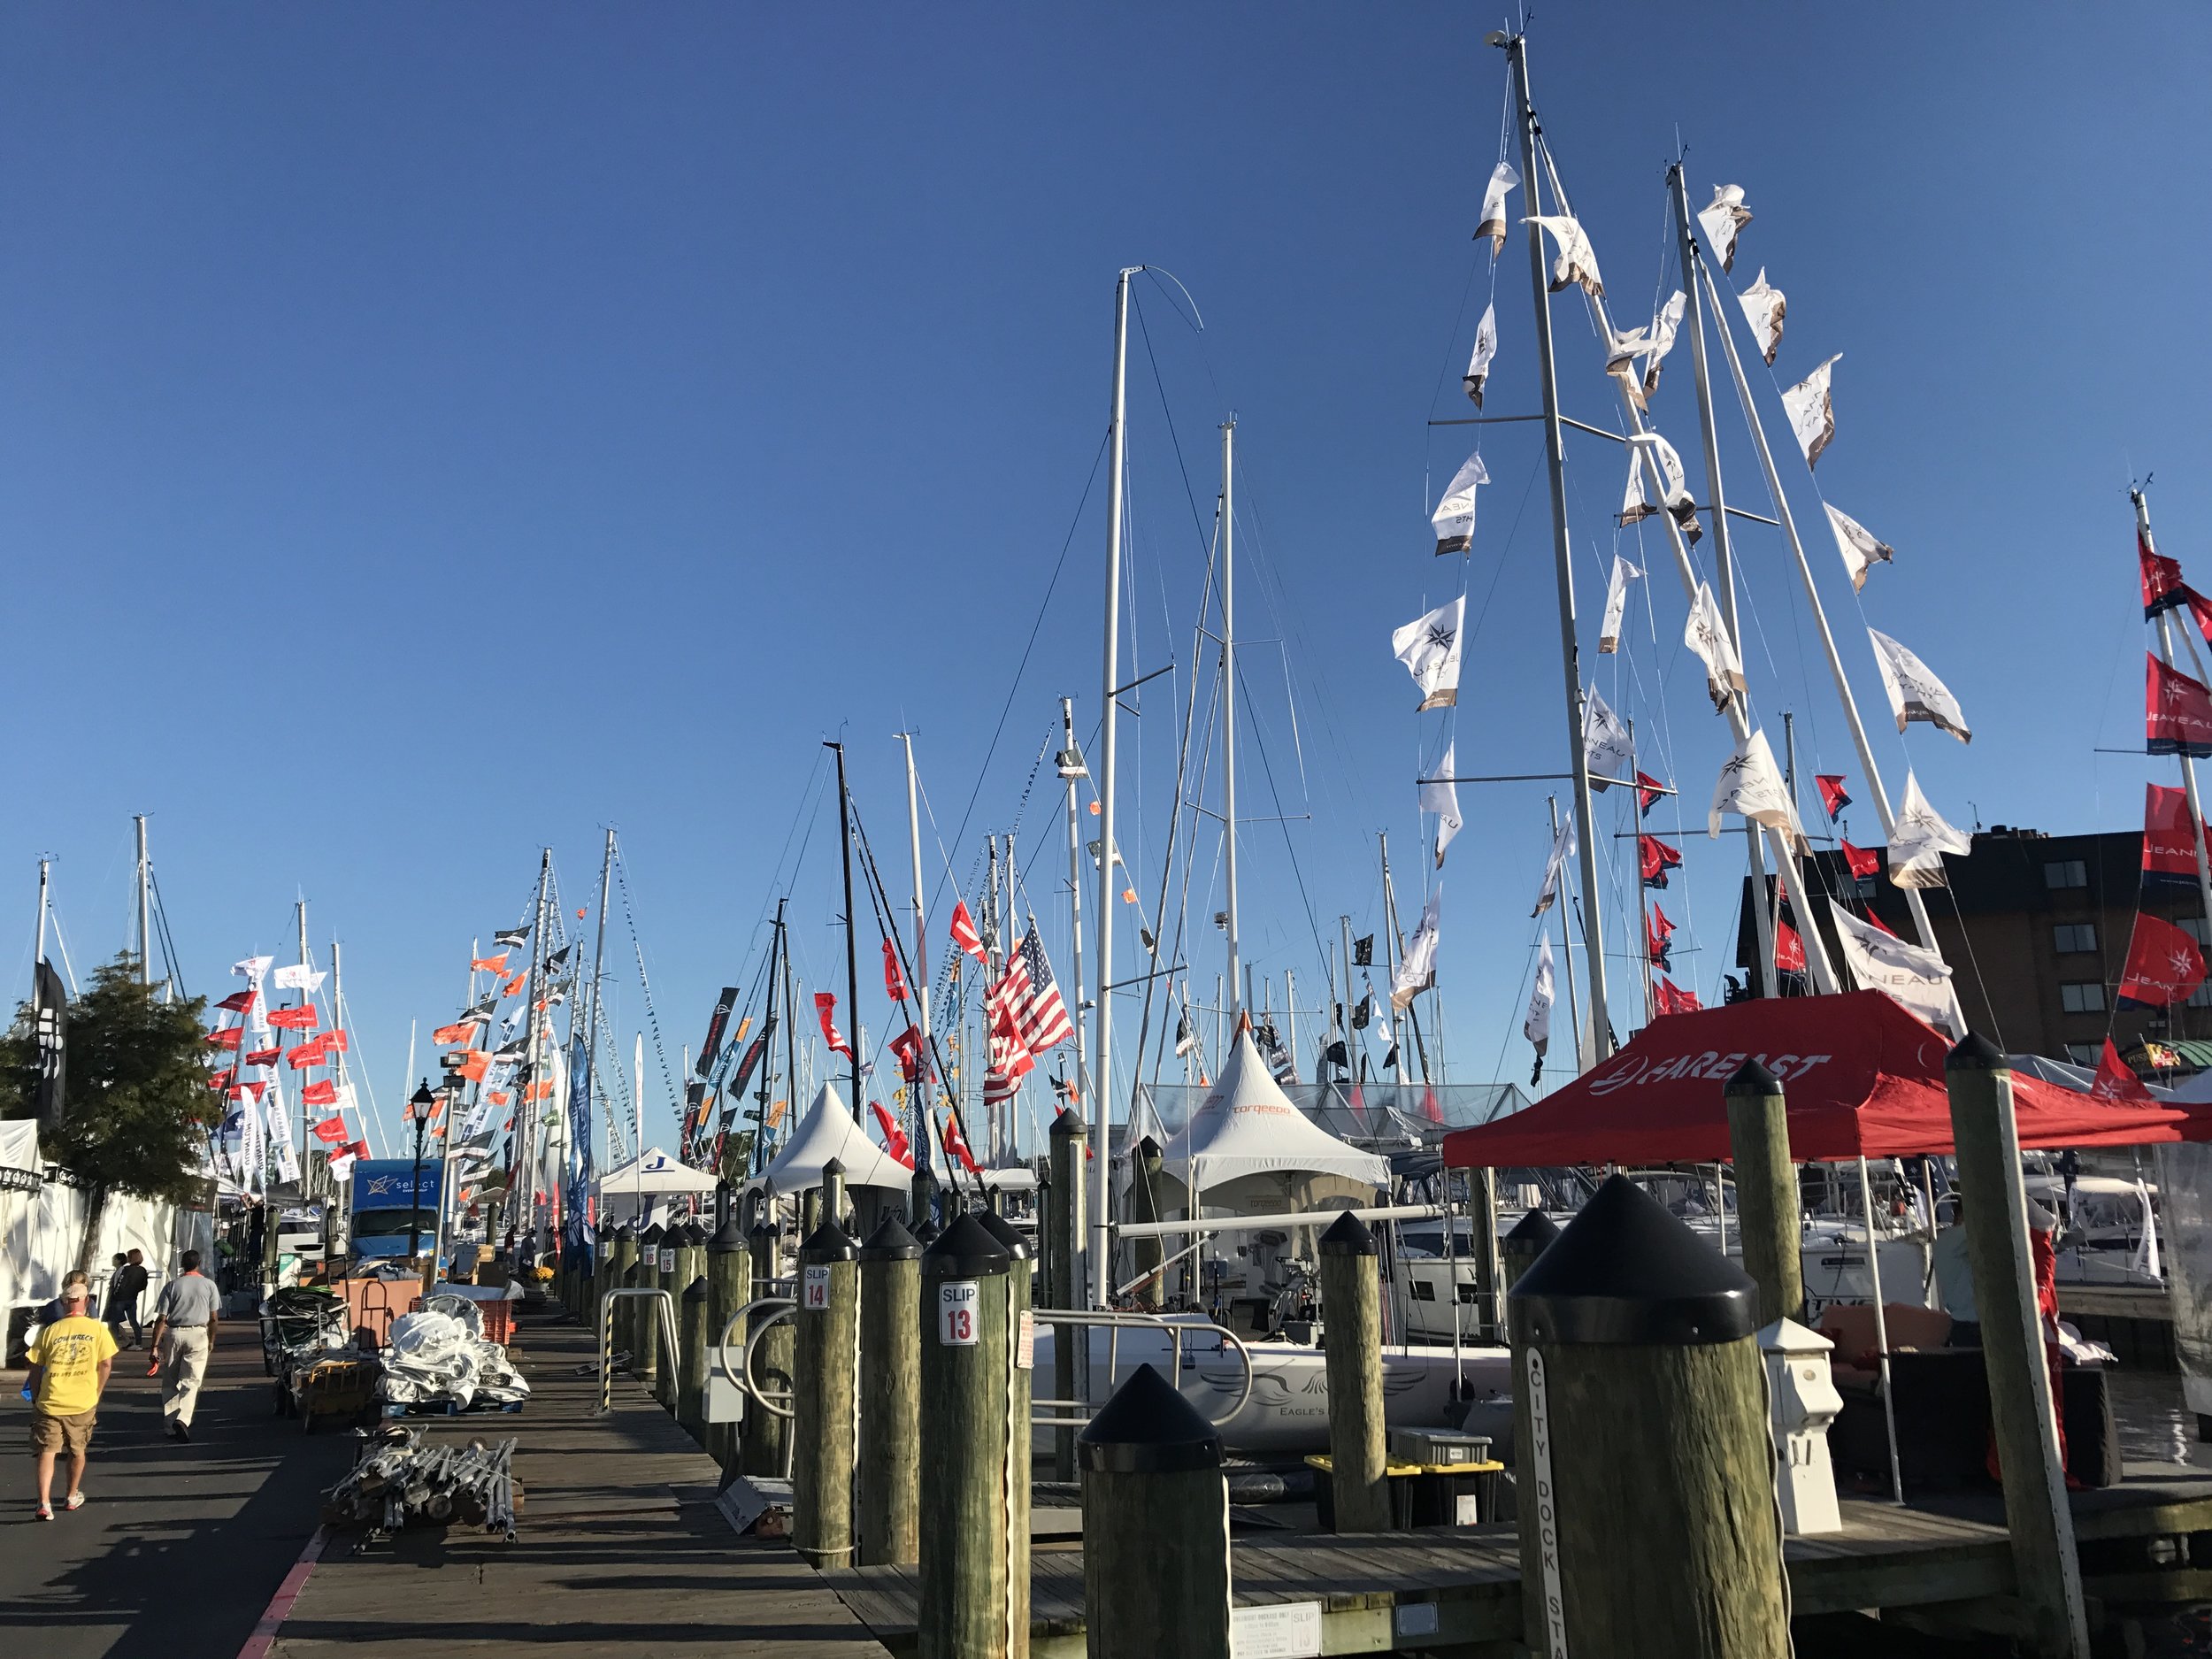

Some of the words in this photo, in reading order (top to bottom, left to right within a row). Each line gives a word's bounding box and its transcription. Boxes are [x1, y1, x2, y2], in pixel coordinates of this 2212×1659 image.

[396, 1179, 434, 1189] selct
[646, 1253, 654, 1263] 16
[663, 1259, 672, 1271] 15
[806, 1269, 828, 1279] SLIP
[809, 1285, 824, 1305] 14
[942, 1288, 976, 1302] SLIP
[948, 1310, 972, 1340] 13
[1530, 1371, 1545, 1457] CITY
[1538, 1480, 1555, 1572] DOCK
[1293, 1612, 1315, 1623] SLIP
[1298, 1626, 1310, 1647] 13
